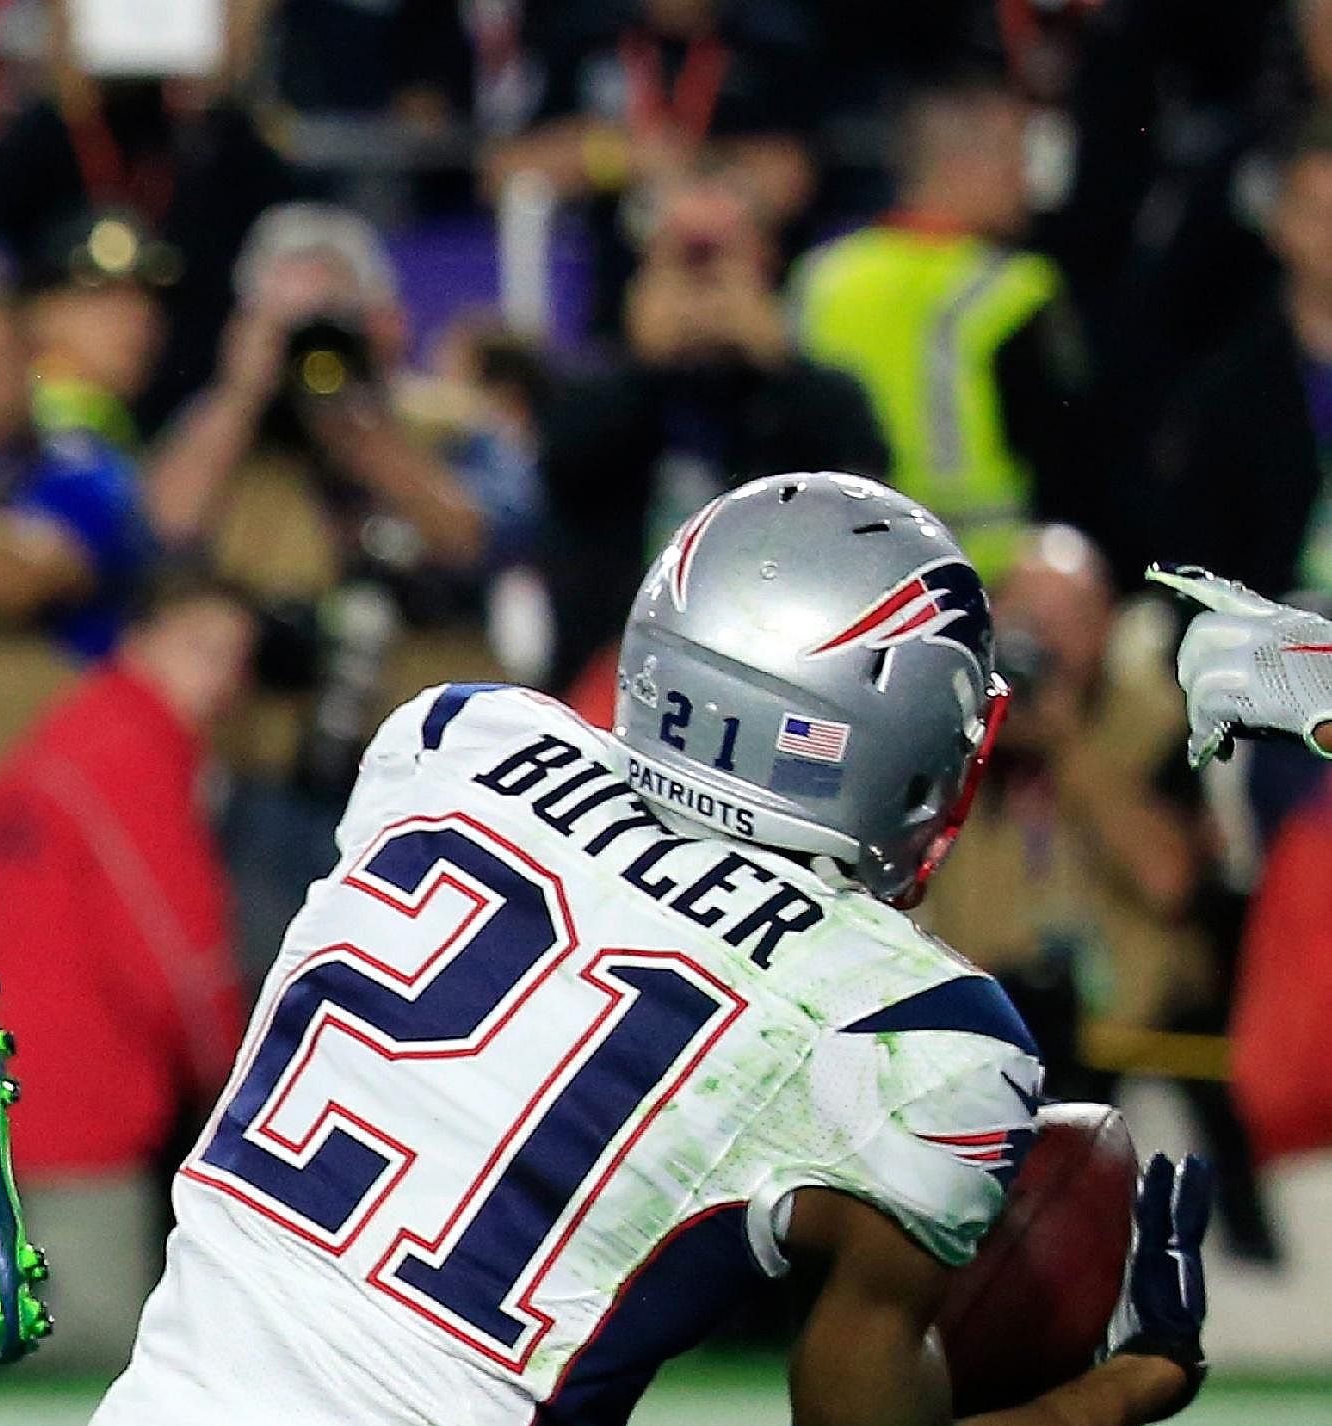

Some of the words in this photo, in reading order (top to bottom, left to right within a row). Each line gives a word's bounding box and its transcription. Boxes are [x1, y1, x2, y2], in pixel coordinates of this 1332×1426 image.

[629, 757, 756, 838] PATRIOTS
[660, 690, 740, 772] 21
[472, 733, 825, 971] BUTLER
[177, 810, 750, 1375] 21
